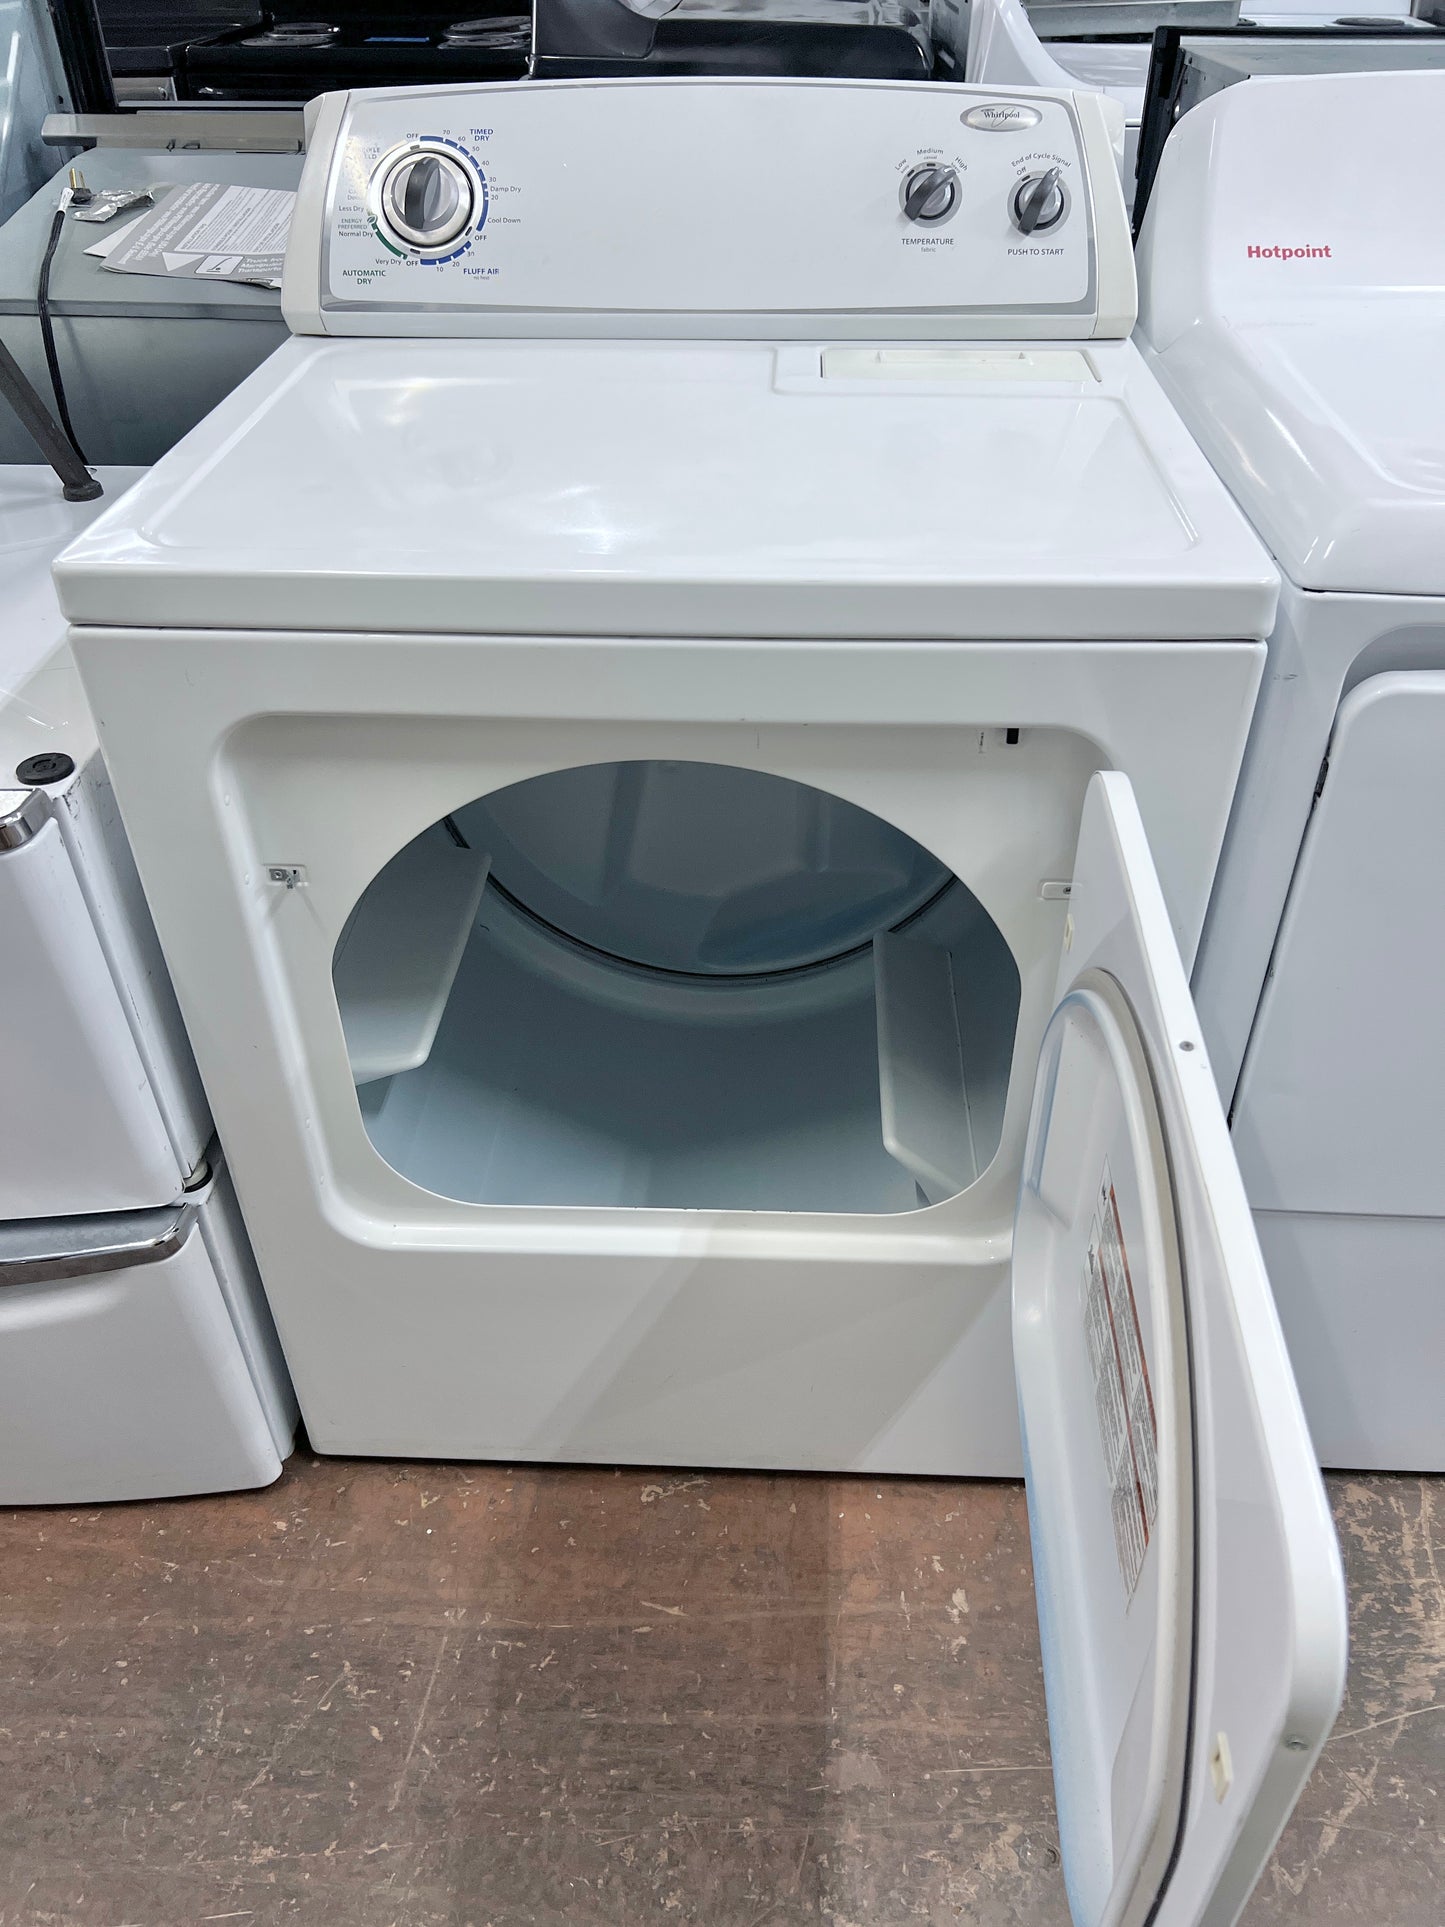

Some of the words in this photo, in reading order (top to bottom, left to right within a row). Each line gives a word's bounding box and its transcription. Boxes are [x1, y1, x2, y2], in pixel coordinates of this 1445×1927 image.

[983, 111, 1020, 120] Whirlpool
[894, 158, 907, 171] Low
[954, 156, 968, 171] High
[1011, 156, 1025, 168] End
[1024, 153, 1032, 161] of
[1032, 152, 1051, 160] Cycle
[1050, 154, 1072, 168] Signal
[1016, 166, 1027, 176] Off
[353, 205, 364, 213] Dry
[1007, 248, 1028, 256] PUSH
[1029, 248, 1040, 256] TO
[1041, 248, 1064, 256] START
[1247, 244, 1332, 260] Hotpoint
[375, 258, 389, 266] Very
[390, 258, 401, 266] Dry
